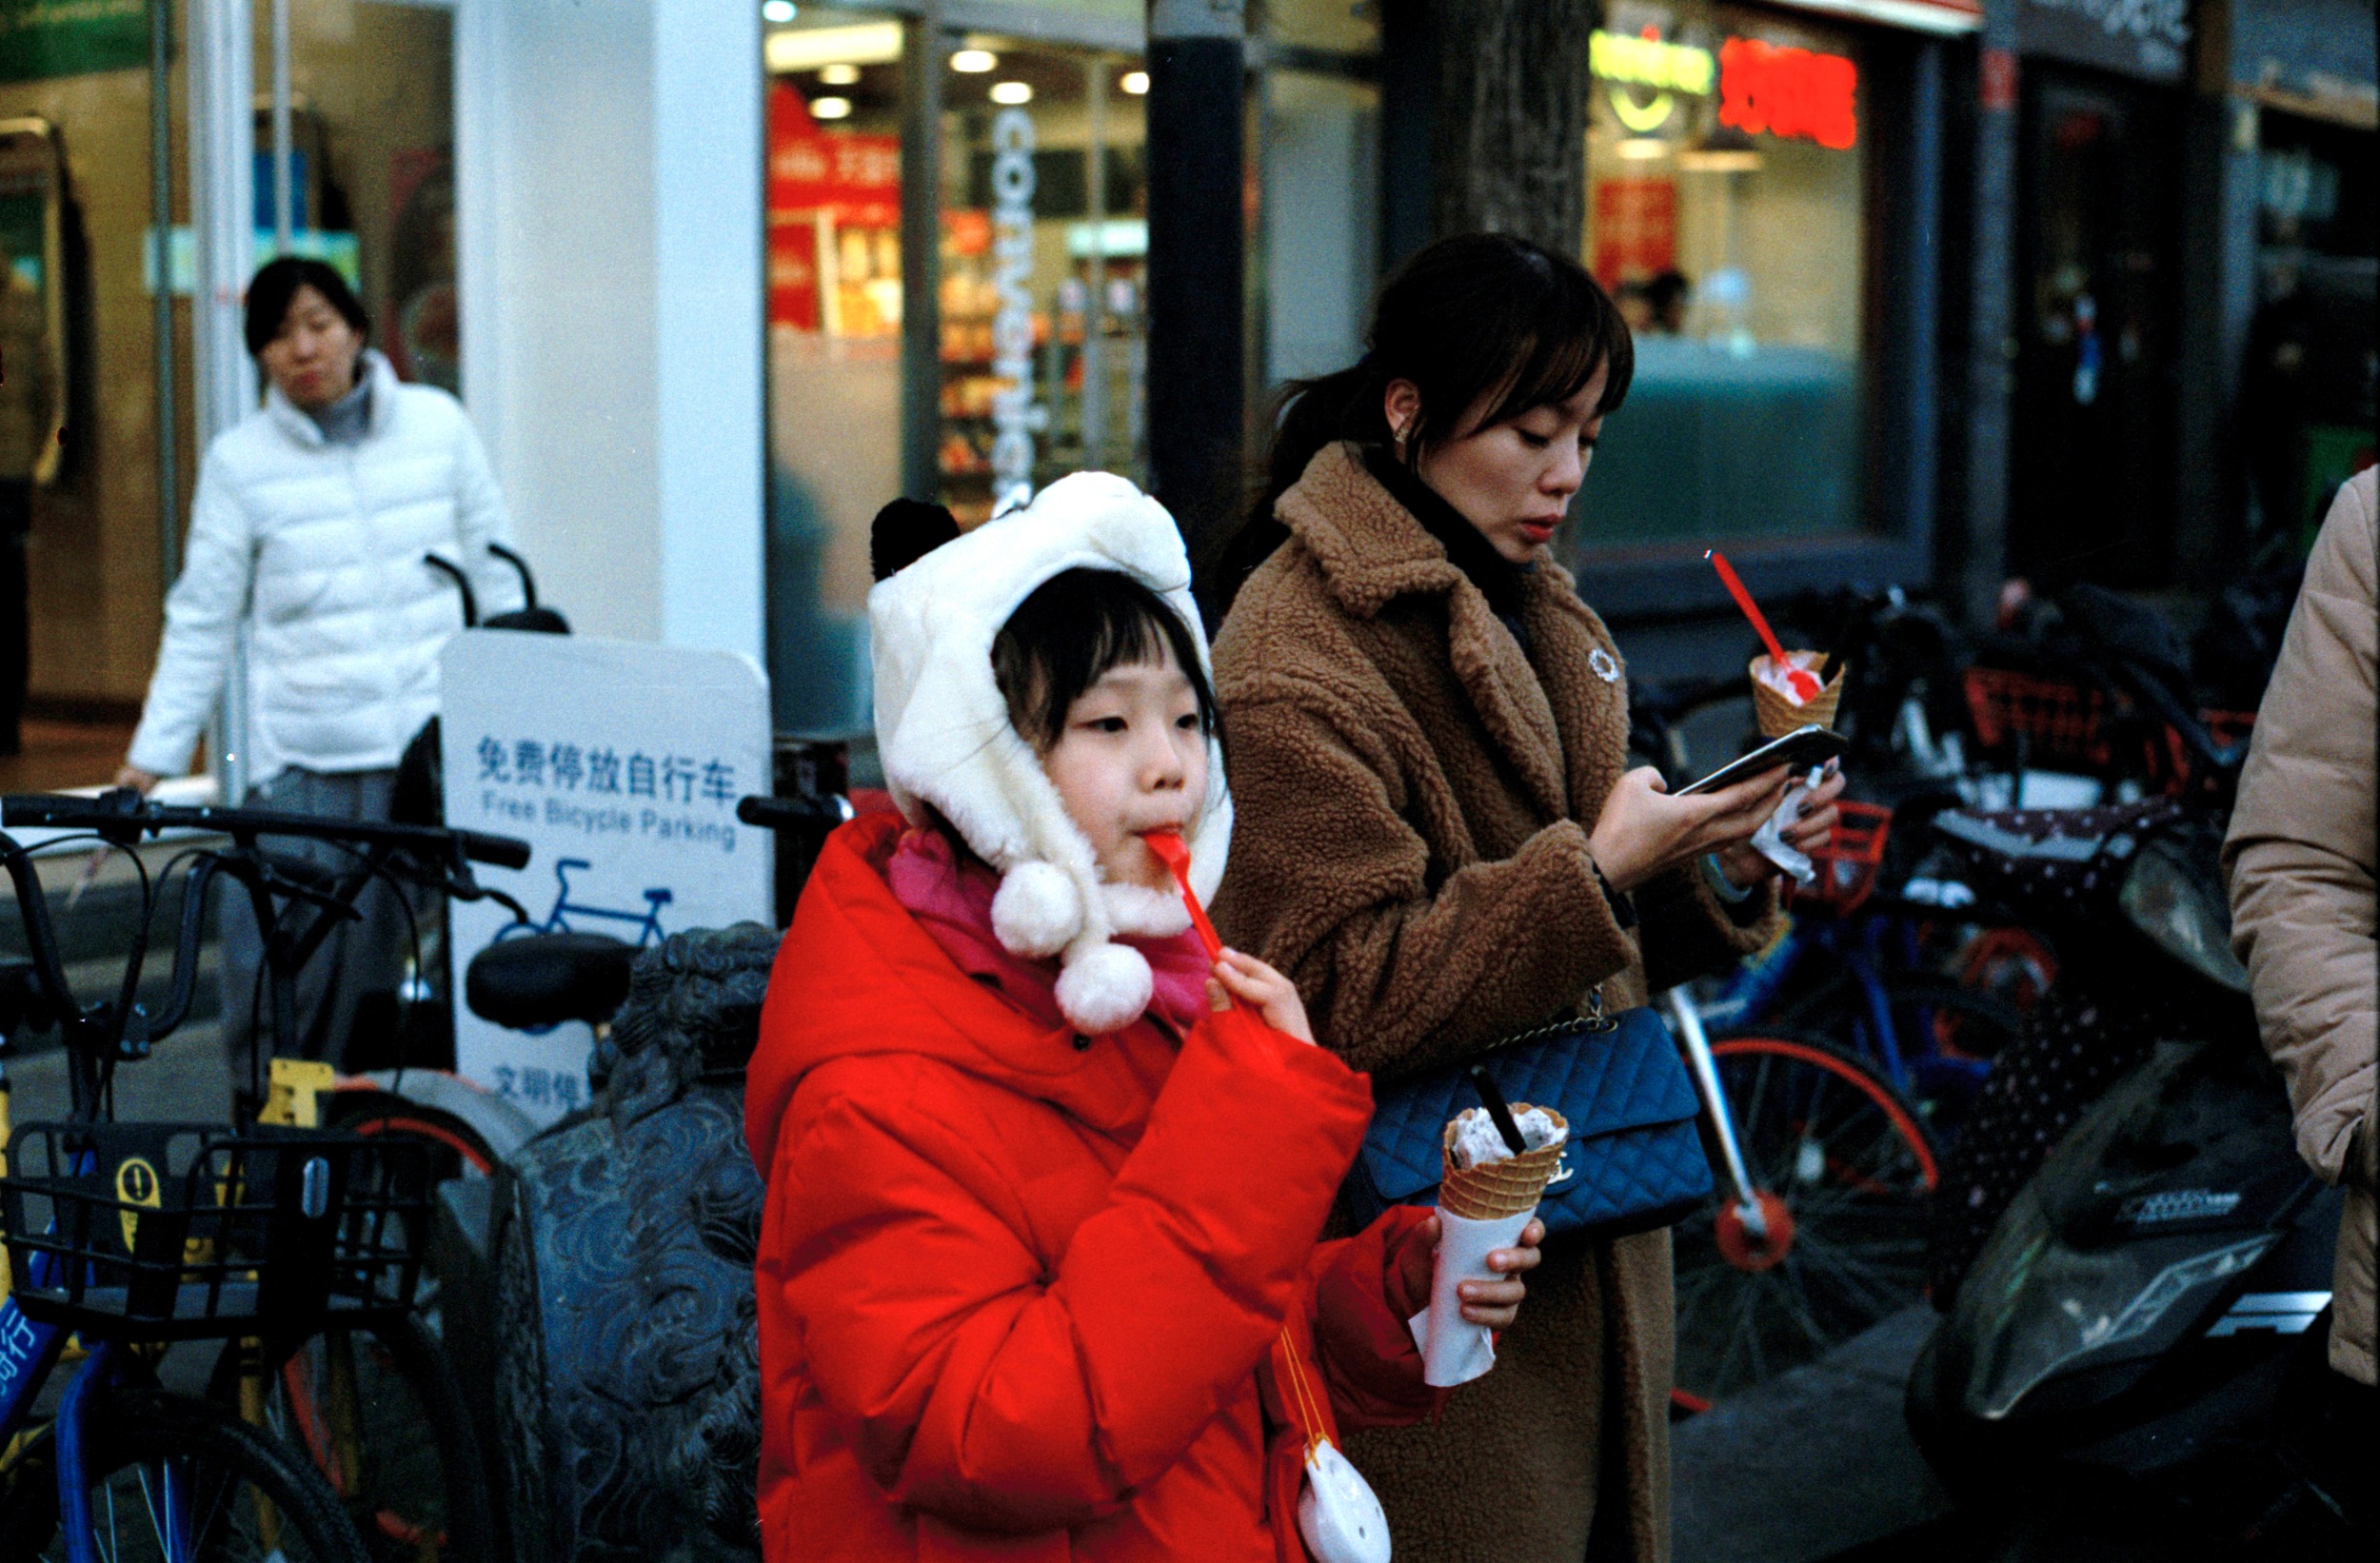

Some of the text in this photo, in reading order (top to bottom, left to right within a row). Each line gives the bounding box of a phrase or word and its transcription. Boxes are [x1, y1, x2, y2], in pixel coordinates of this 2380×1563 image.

[478, 735, 736, 807] 免费停放自行车
[482, 790, 736, 853] Free Bicycle Parking
